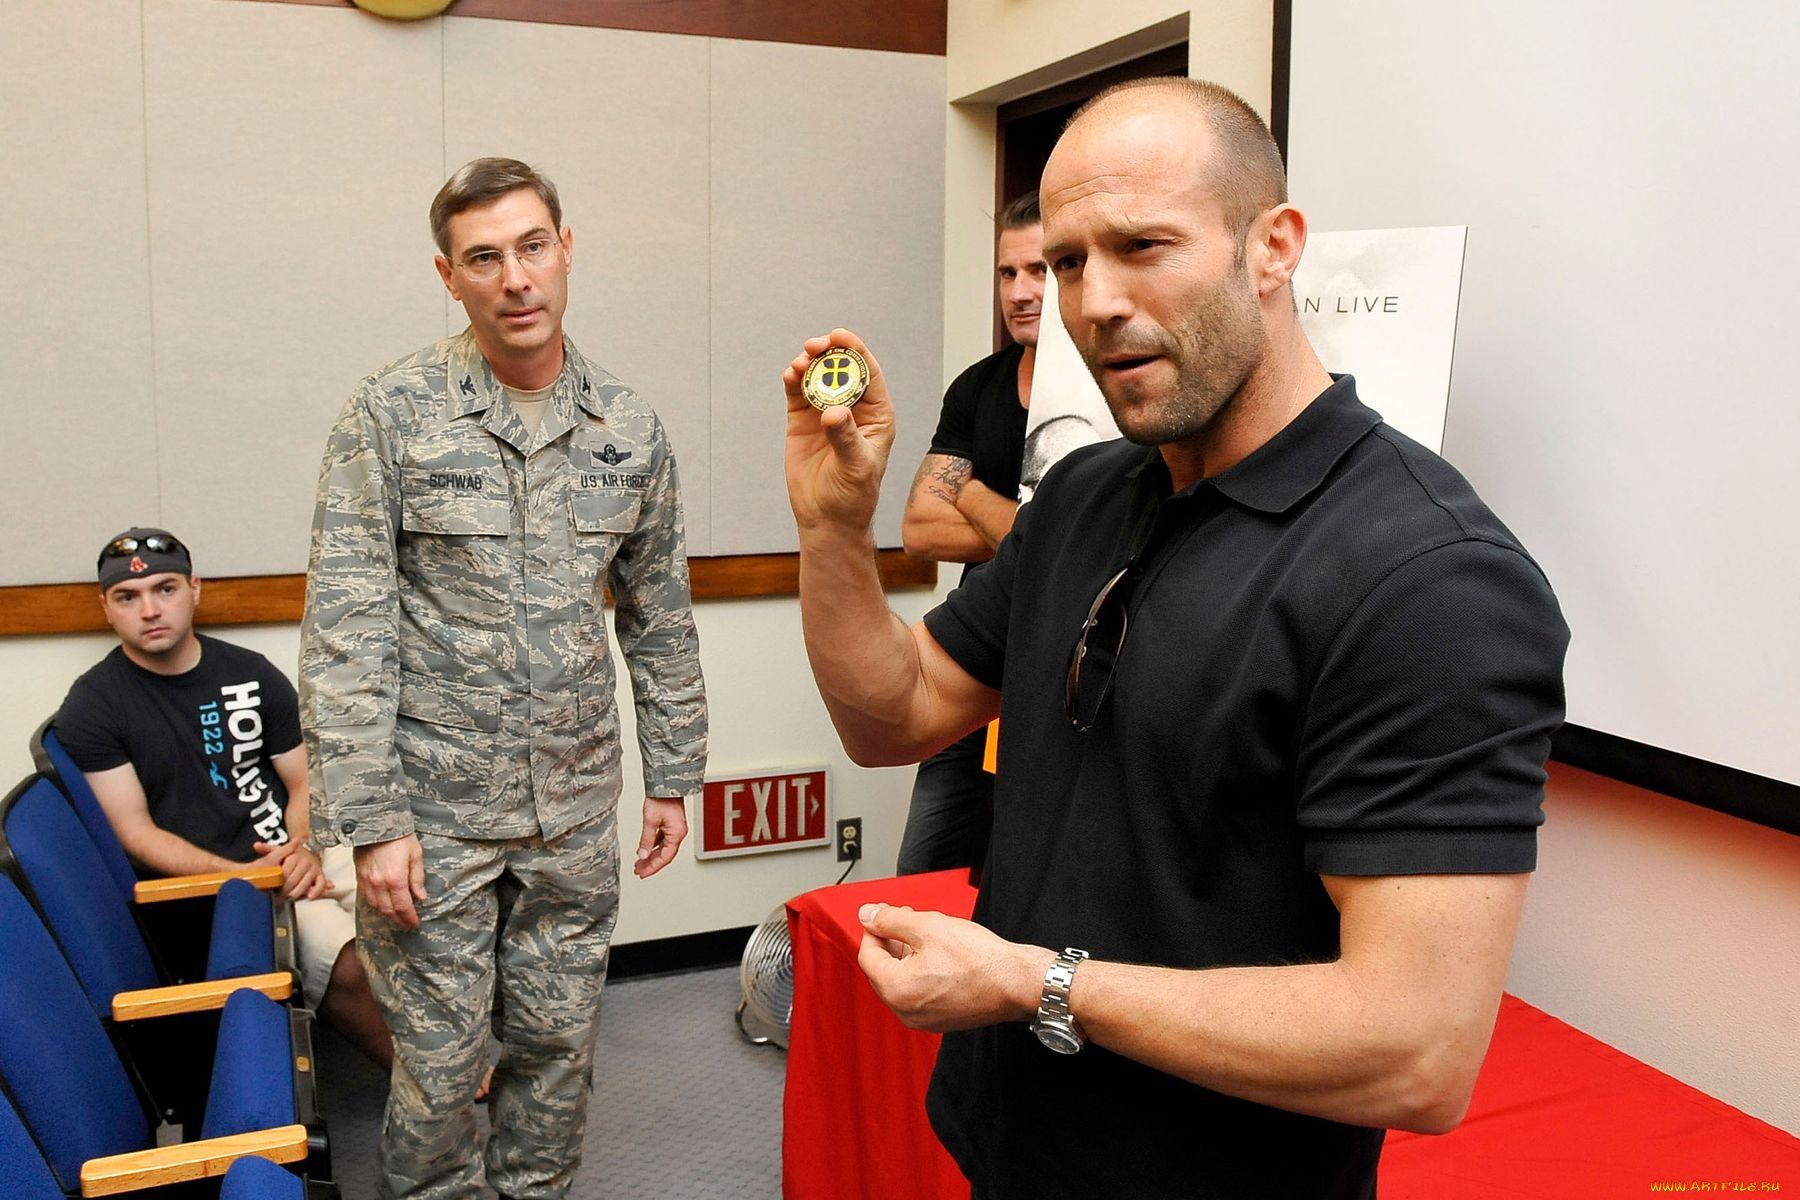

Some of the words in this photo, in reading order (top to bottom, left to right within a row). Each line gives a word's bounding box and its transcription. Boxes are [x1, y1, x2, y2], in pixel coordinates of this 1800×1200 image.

[1336, 296, 1399, 313] LIVE
[429, 474, 482, 490] SCHWAB
[602, 473, 619, 487] AIR
[199, 701, 224, 755] 1922
[724, 778, 811, 845] EXIT
